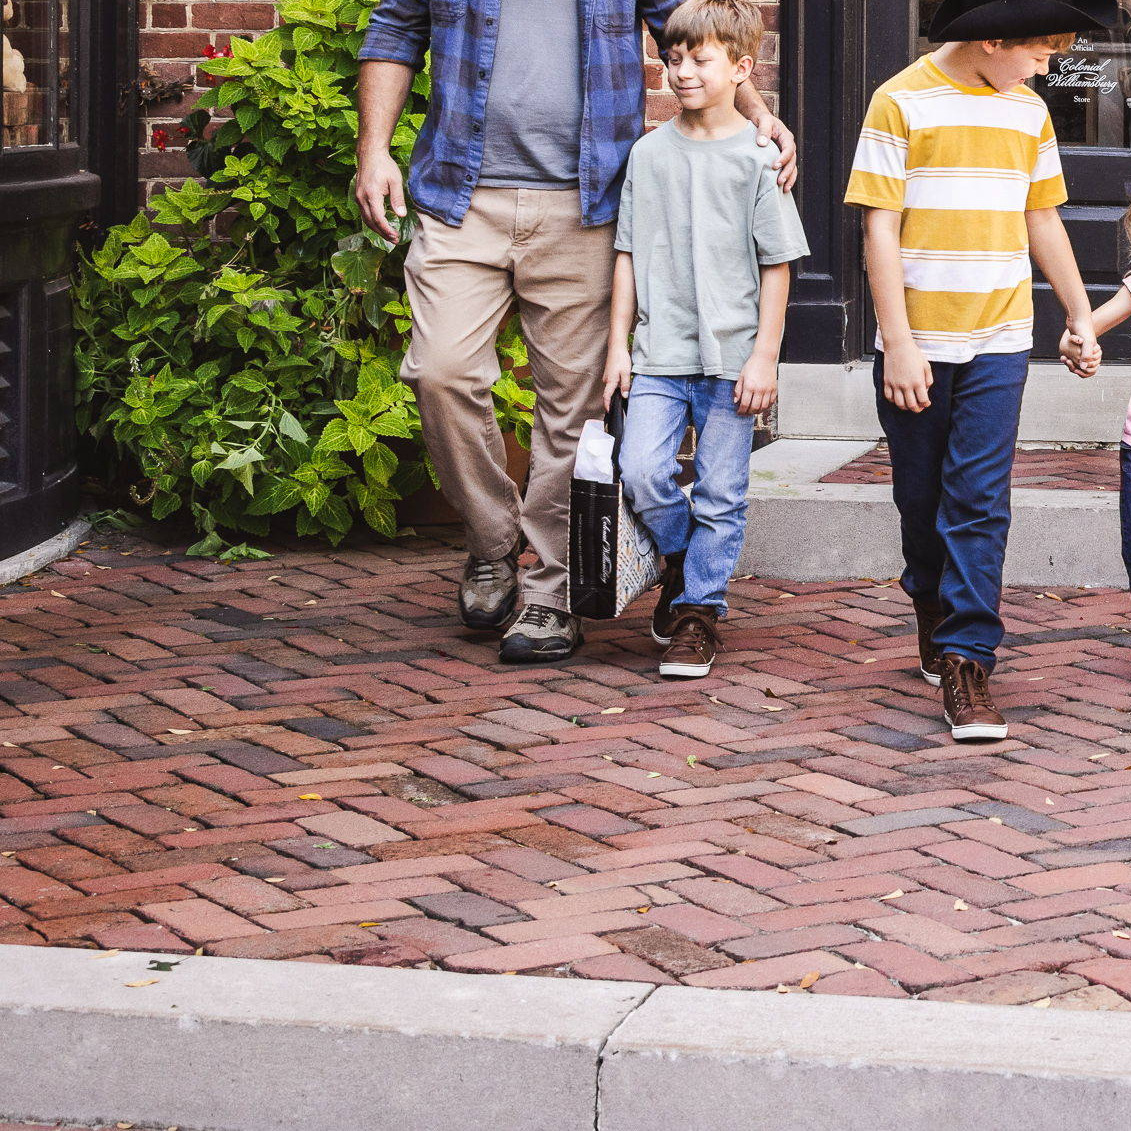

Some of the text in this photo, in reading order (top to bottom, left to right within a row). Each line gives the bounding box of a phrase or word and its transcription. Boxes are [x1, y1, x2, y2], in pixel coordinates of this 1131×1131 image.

[1070, 44, 1095, 52] Official
[1057, 58, 1112, 74] Colonial
[1046, 71, 1118, 94] Williamsburg
